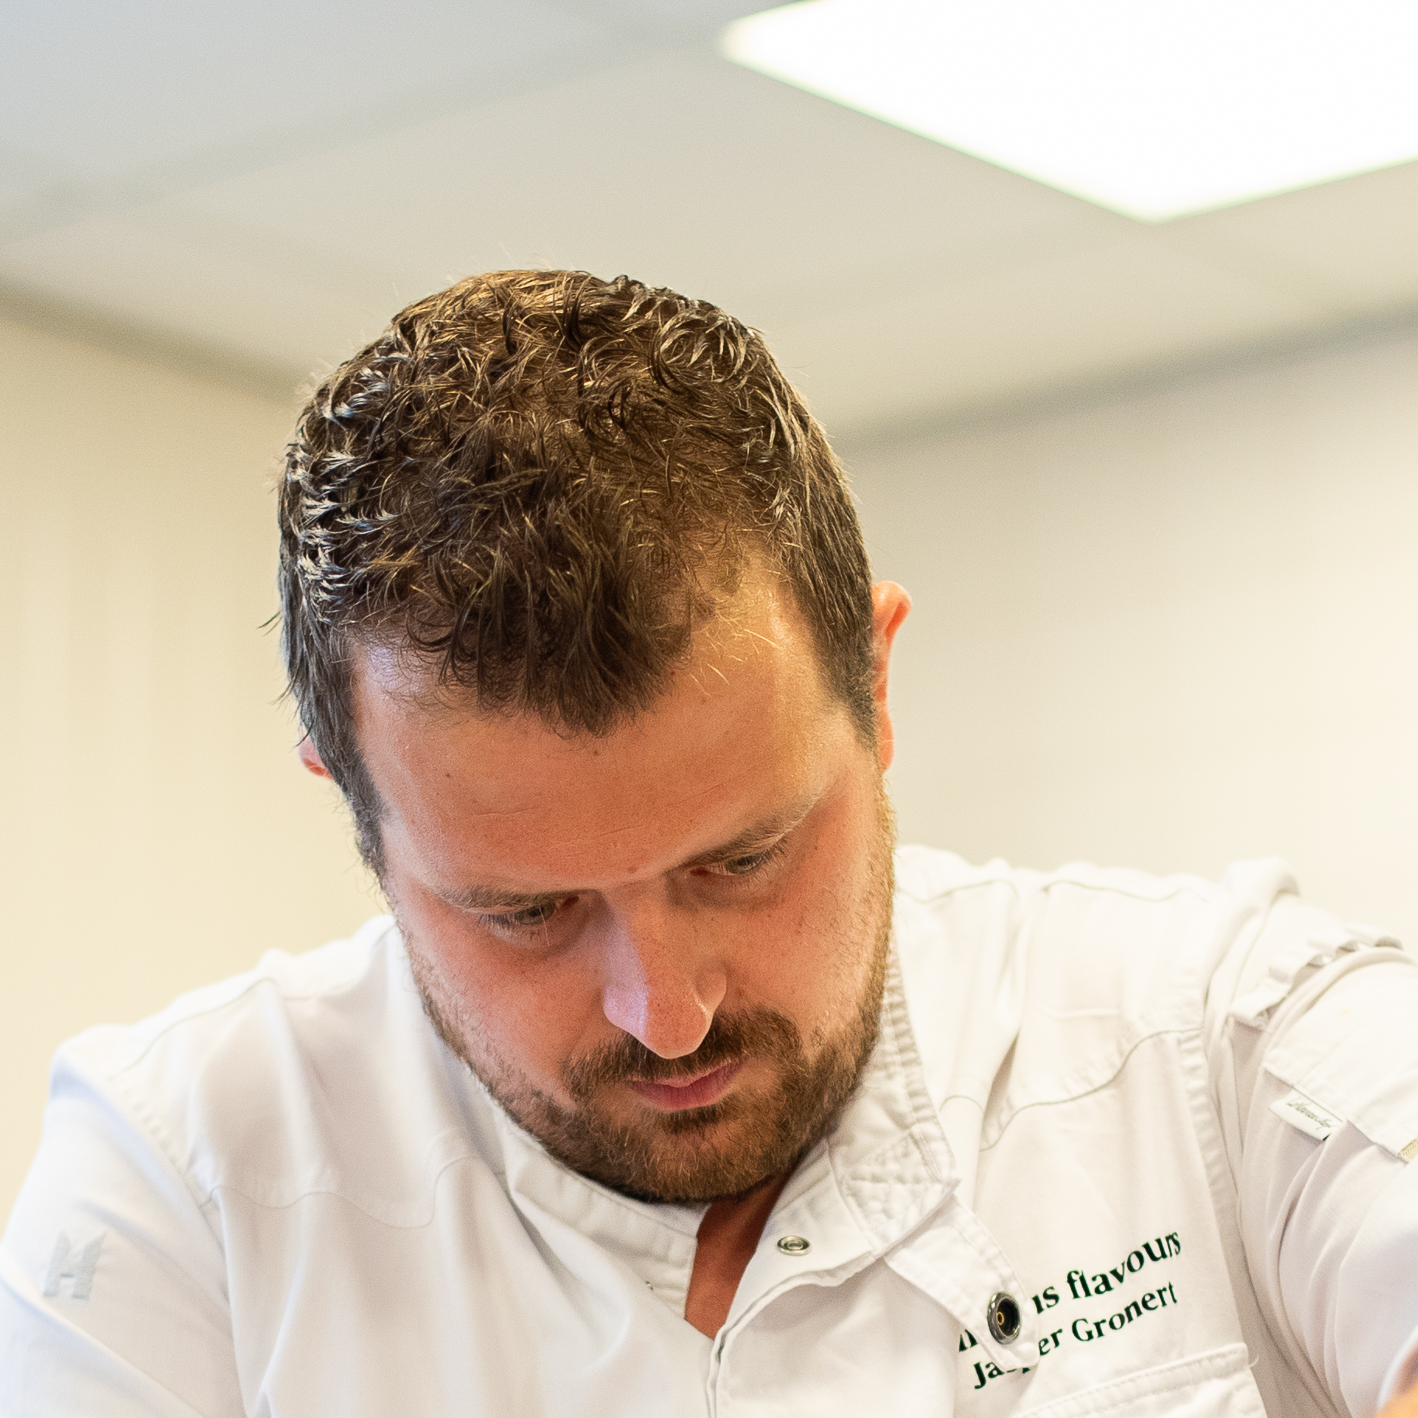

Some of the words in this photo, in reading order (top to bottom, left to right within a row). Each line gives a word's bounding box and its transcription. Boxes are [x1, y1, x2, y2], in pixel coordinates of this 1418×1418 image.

[1066, 1231, 1182, 1300] flavours
[972, 1327, 1064, 1390] Jaer
[1071, 1281, 1178, 1342] Gronert
